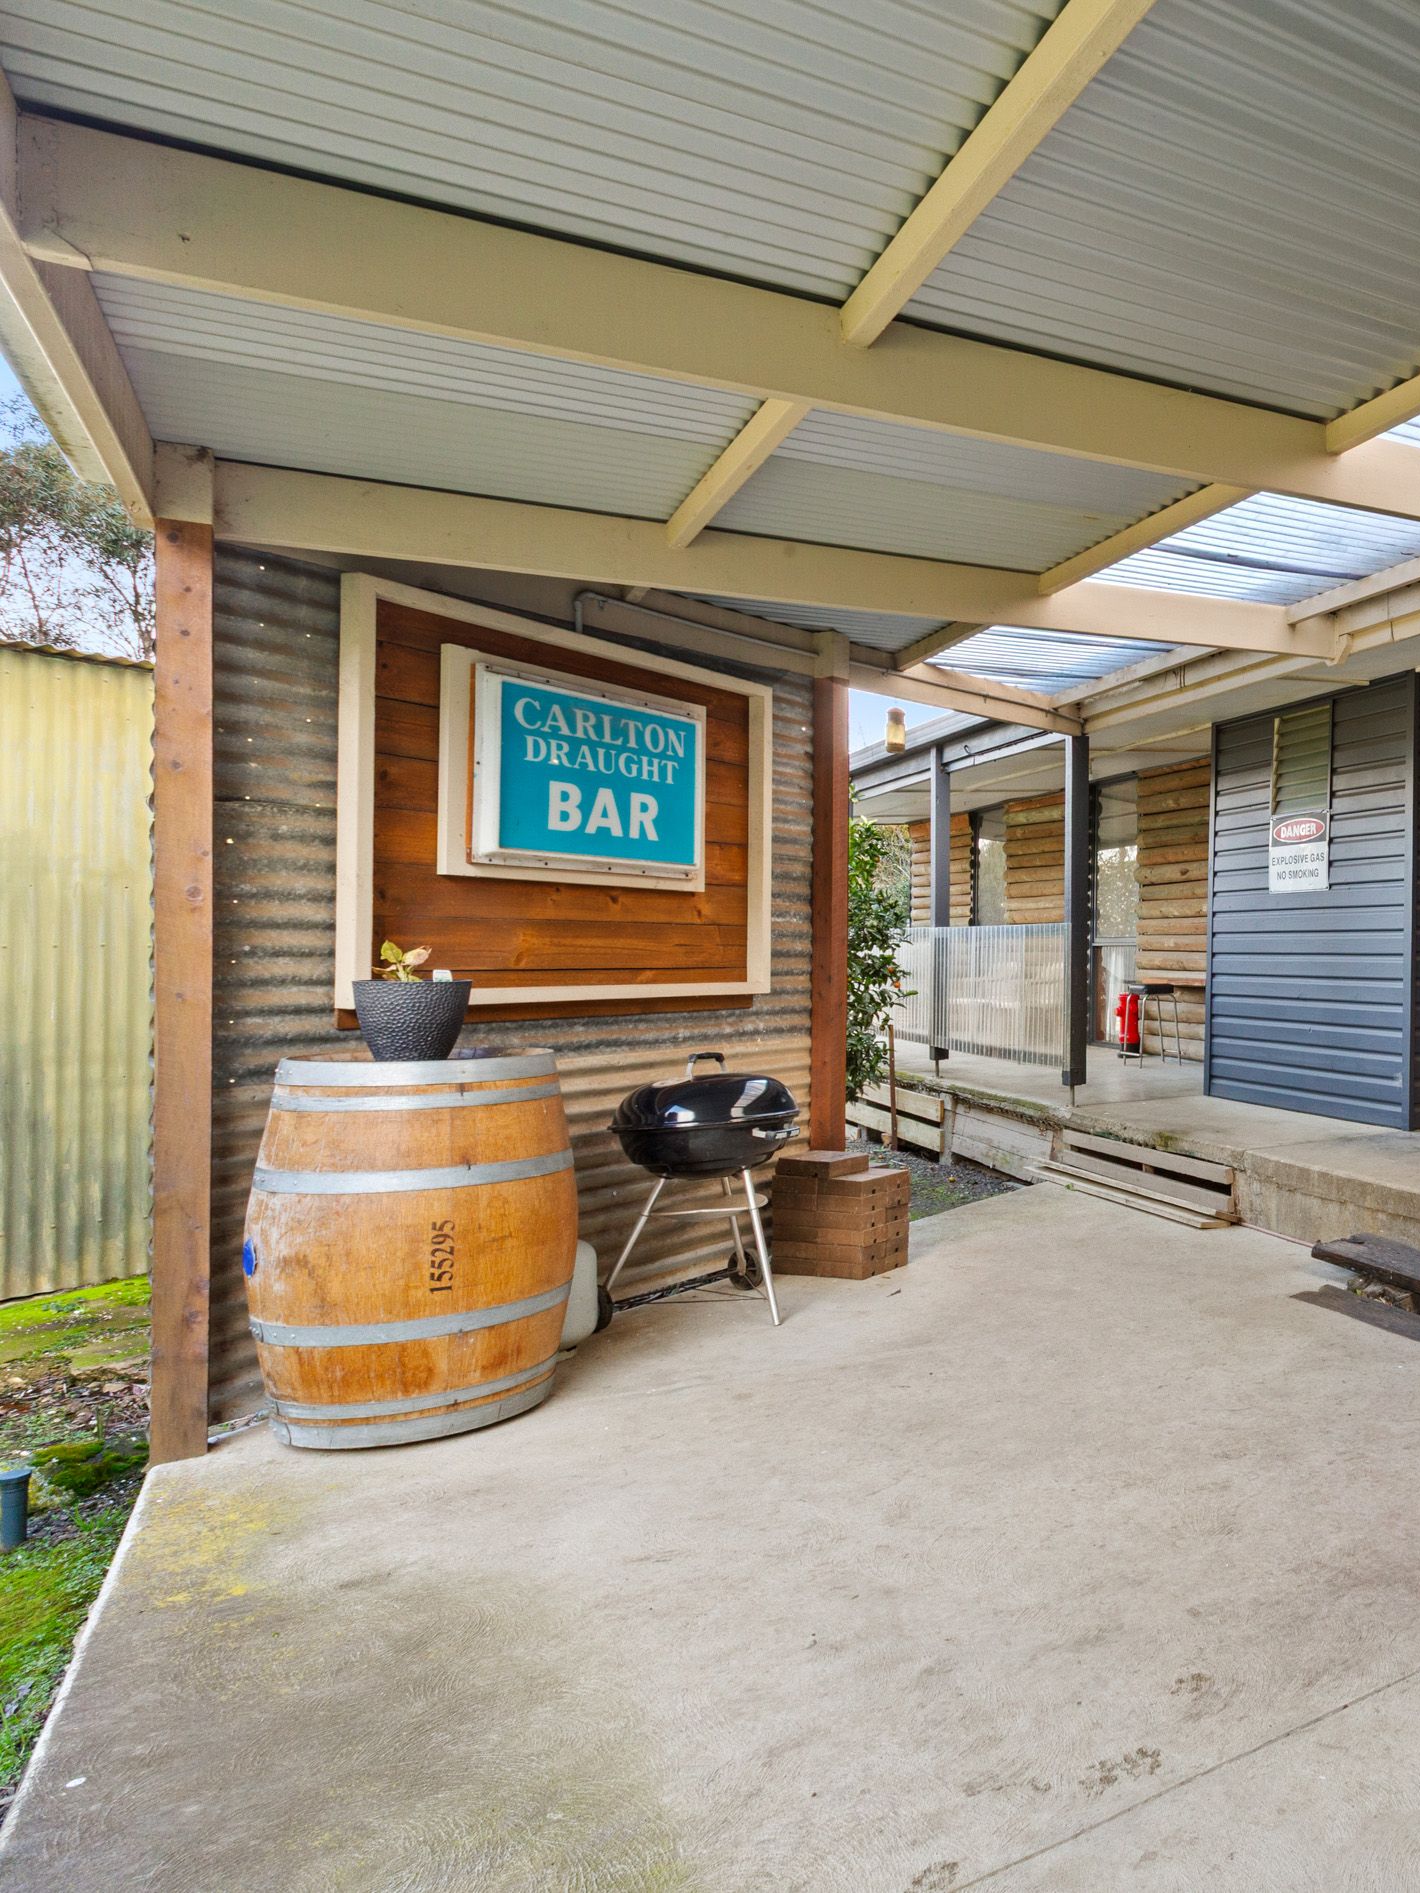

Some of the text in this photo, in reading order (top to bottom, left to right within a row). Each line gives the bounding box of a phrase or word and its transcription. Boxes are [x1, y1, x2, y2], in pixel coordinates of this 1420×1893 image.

[513, 697, 687, 758] CARLTON
[523, 735, 679, 784] DRAUGHT
[547, 780, 660, 842] BAR
[1280, 822, 1317, 838] DANGER
[1272, 852, 1325, 866] EXPLOSIVE GAS
[1277, 868, 1319, 880] NO SMOKING
[429, 1220, 455, 1294] 155295
